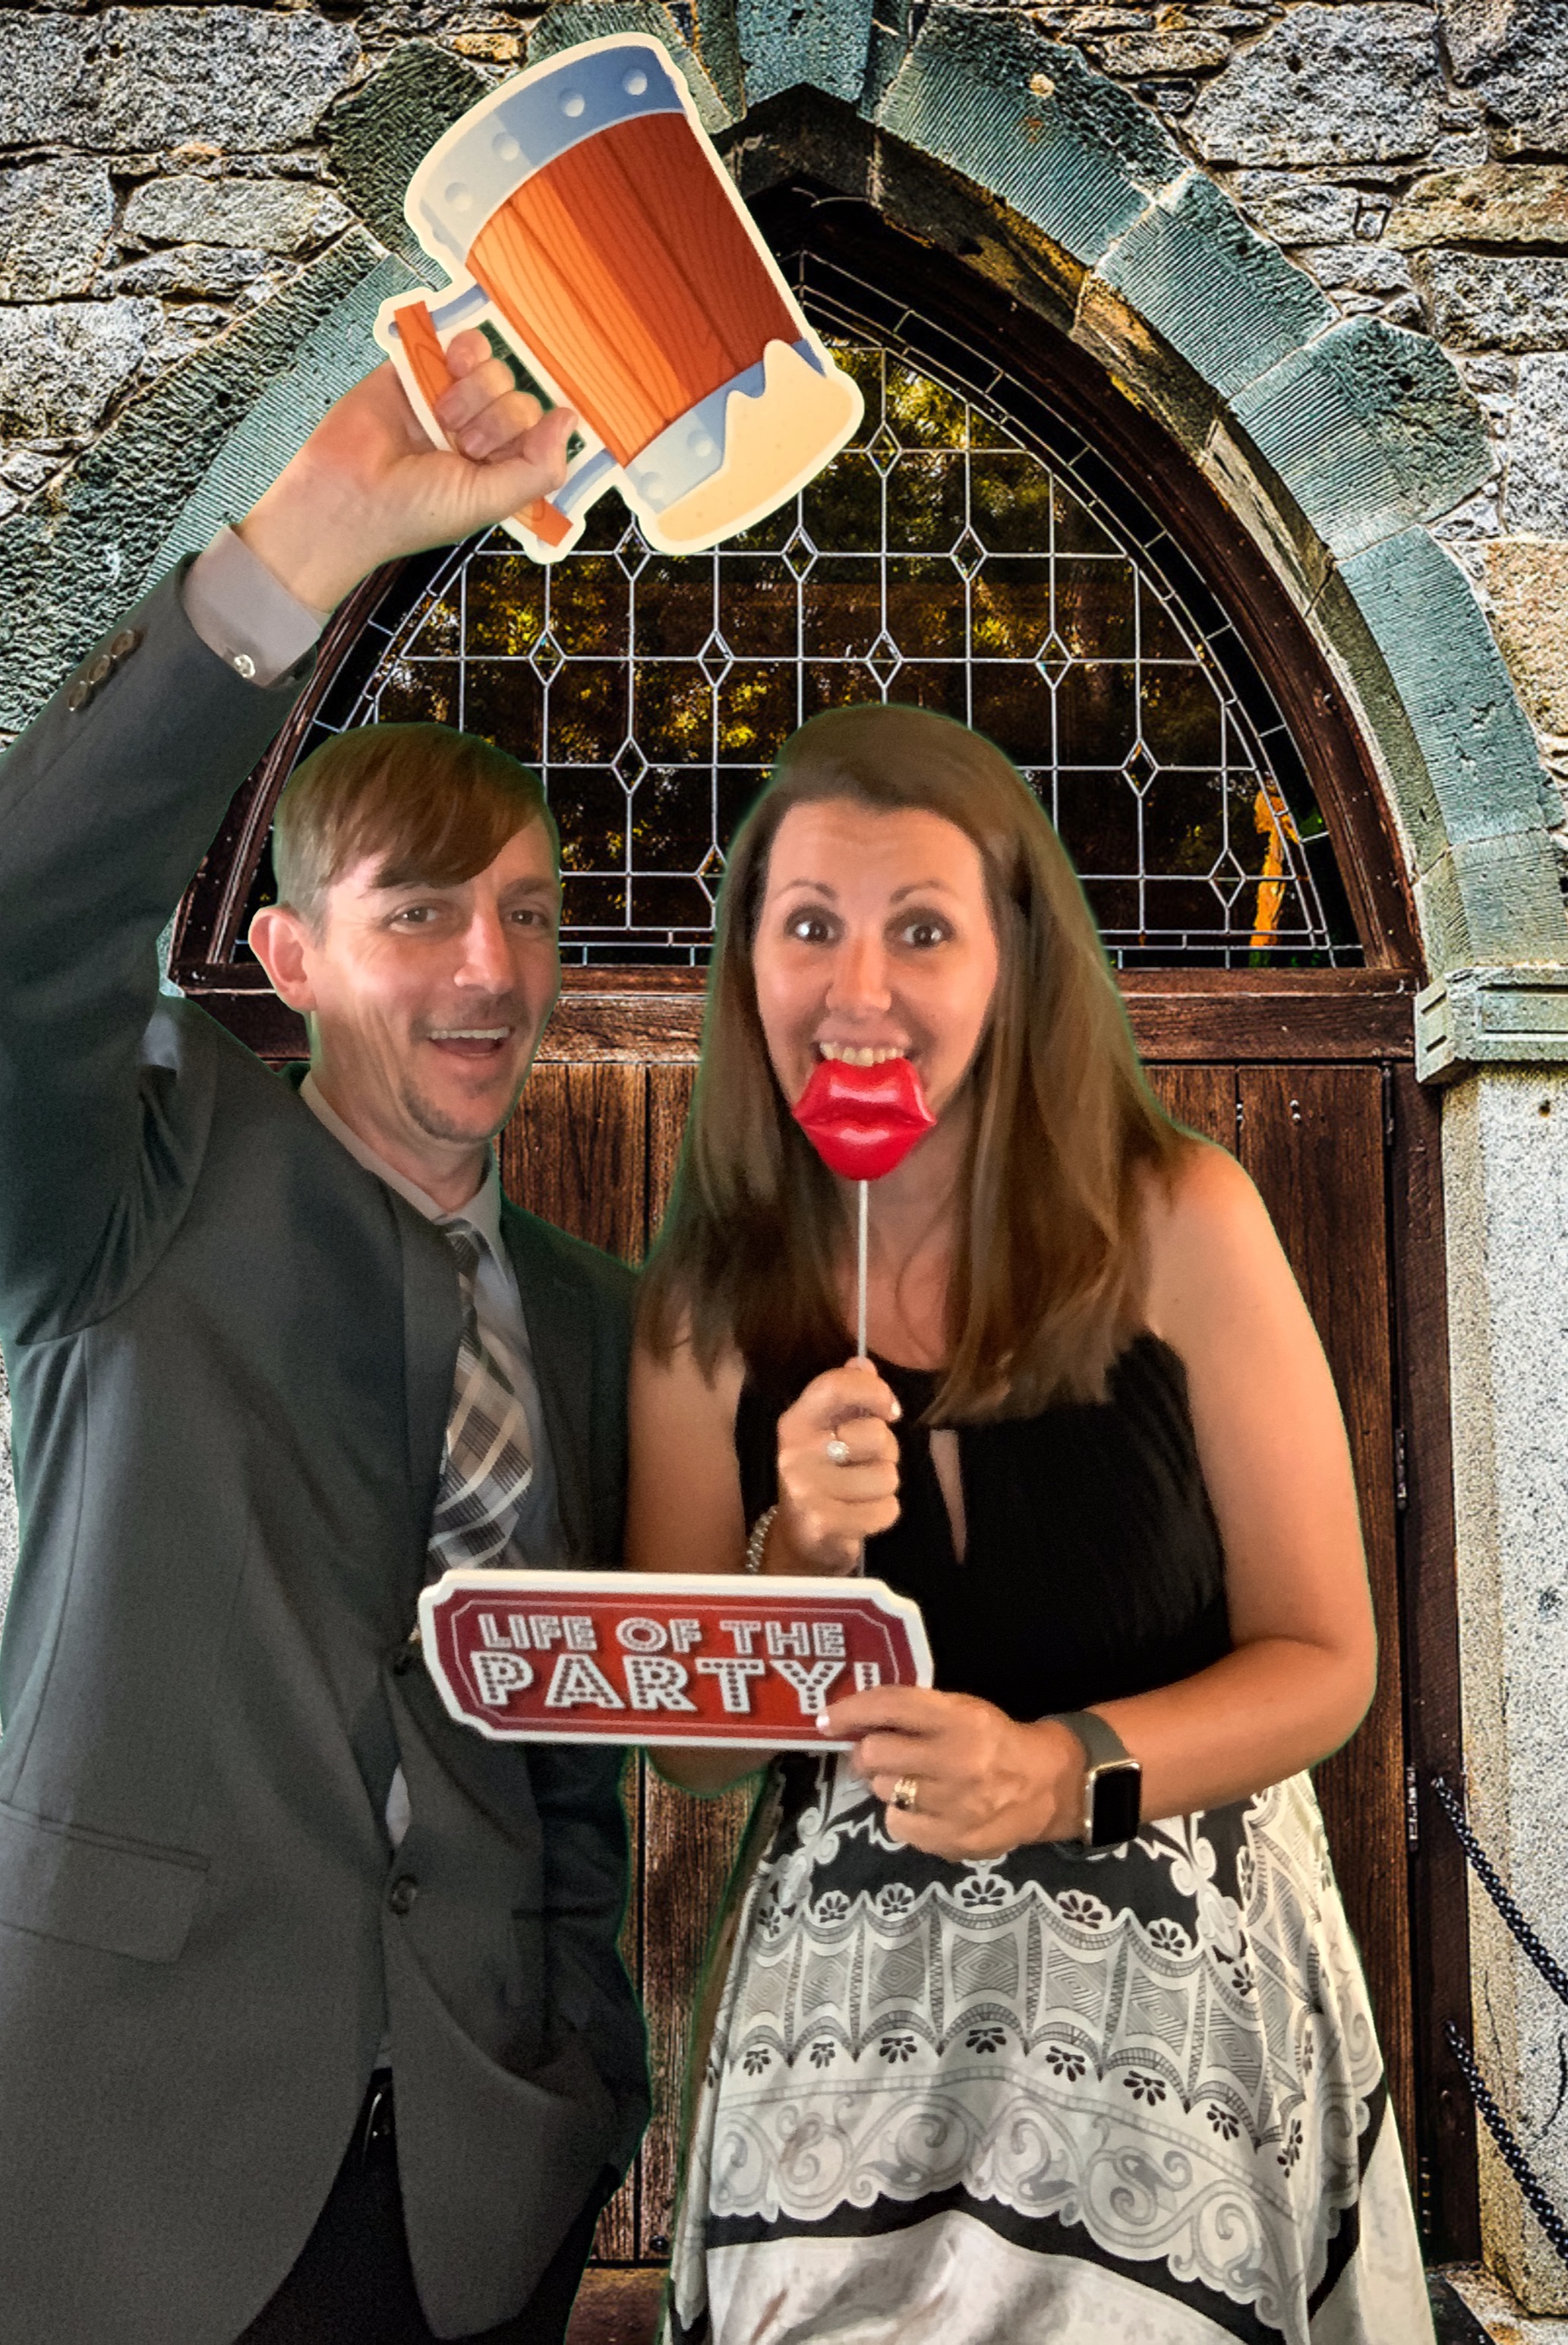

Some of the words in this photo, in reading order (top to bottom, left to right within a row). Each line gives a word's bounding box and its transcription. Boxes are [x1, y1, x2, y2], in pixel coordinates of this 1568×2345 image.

[478, 1613, 598, 1652] LIFE
[615, 1617, 702, 1654] OF
[720, 1620, 847, 1658] THE
